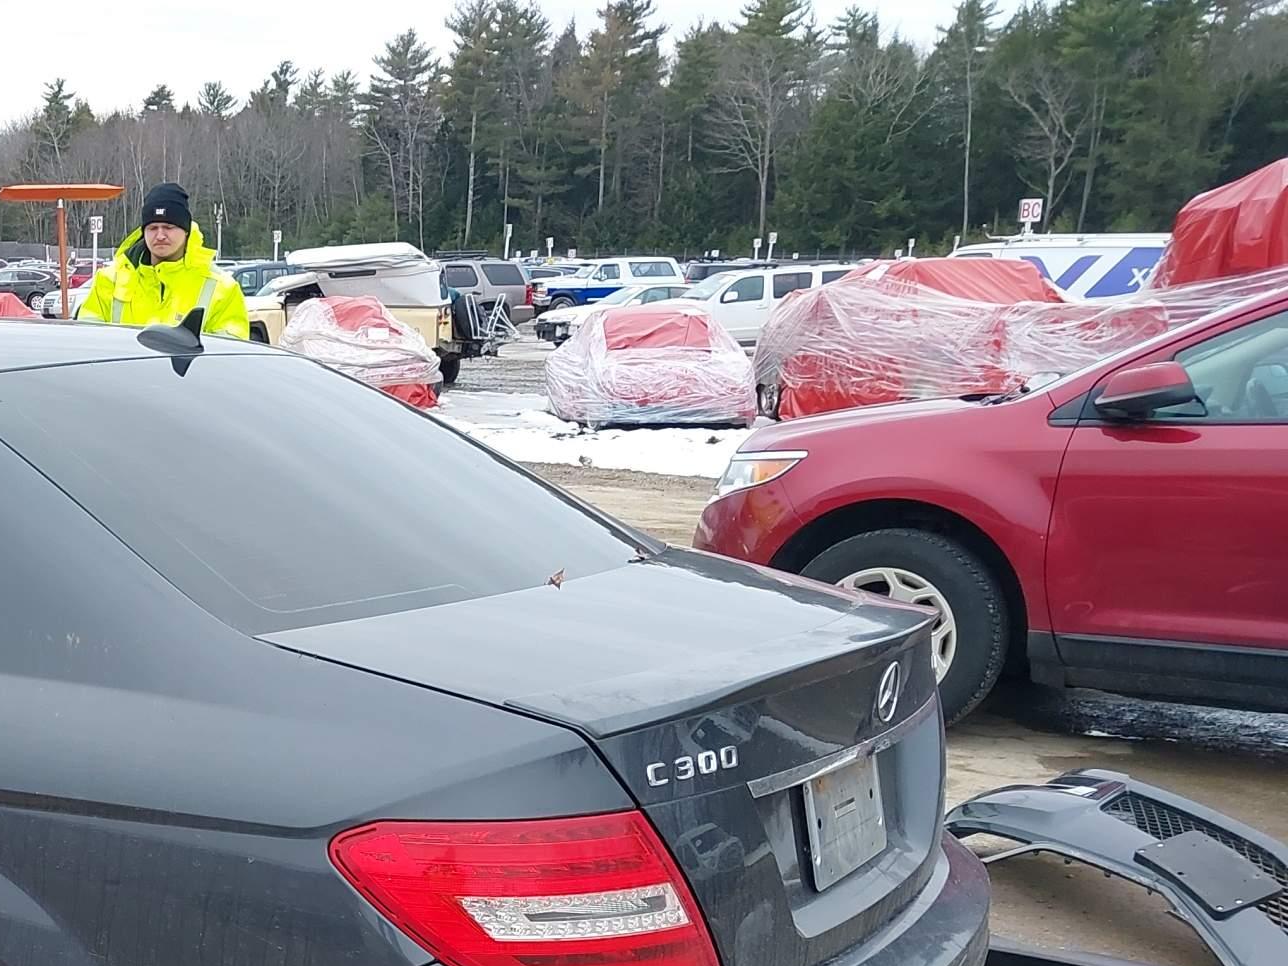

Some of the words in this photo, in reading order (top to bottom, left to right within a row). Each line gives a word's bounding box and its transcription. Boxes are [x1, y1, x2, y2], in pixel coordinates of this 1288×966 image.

[1021, 202, 1041, 218] BC
[646, 762, 669, 787] C
[674, 745, 739, 780] 300
